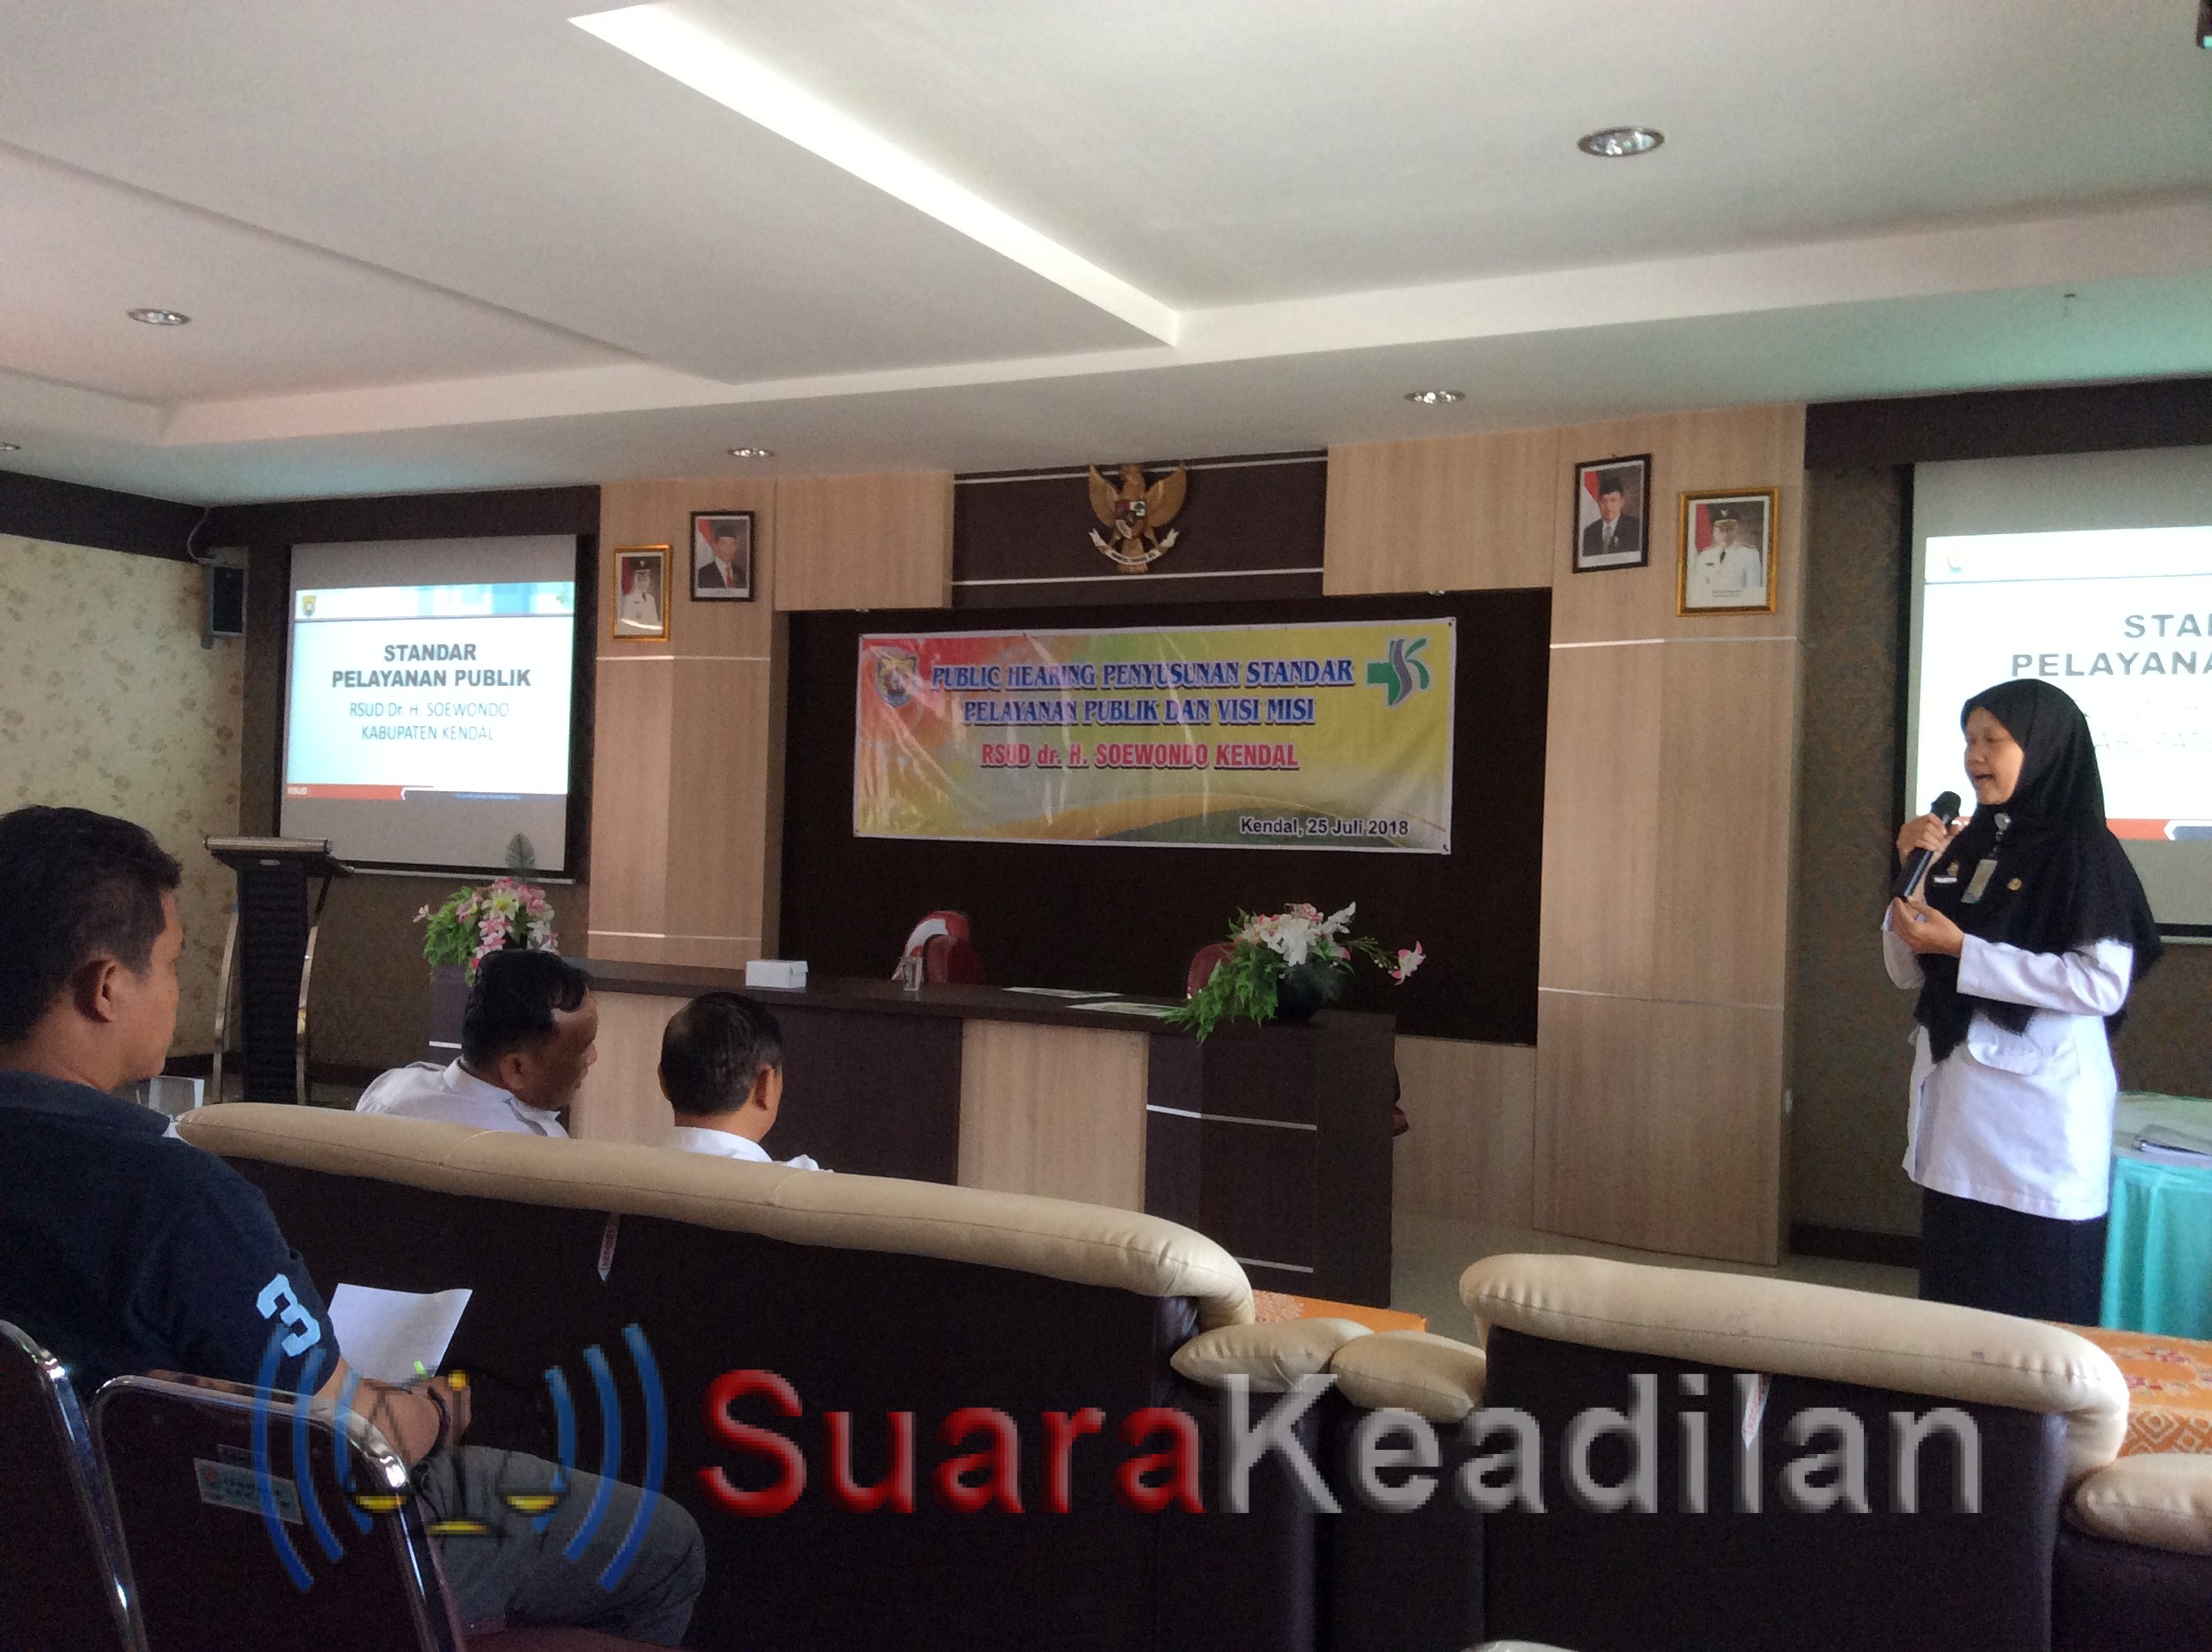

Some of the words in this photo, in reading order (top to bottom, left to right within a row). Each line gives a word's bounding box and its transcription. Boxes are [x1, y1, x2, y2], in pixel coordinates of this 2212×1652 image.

[2124, 614, 2212, 638] STA
[383, 643, 477, 662] STANDAR
[332, 670, 447, 689] PELAYANAN
[454, 668, 532, 688] PUBLIK
[931, 666, 1001, 689] PUBLIC
[1007, 665, 1096, 688] HEARING
[1103, 661, 1240, 686] PENYUSUNAN
[1246, 660, 1354, 684] STANDAR
[349, 702, 385, 718] RSUD
[427, 702, 509, 718] SOEWONDO
[963, 701, 1079, 722] PELAYANAN
[1084, 700, 1160, 722] PUBLIK
[1165, 699, 1210, 721] DAN
[1217, 698, 1260, 721] VISI
[1266, 697, 1315, 720] MISI
[361, 725, 438, 741] KABUPATEN
[442, 726, 494, 741] KENDAL
[981, 743, 1031, 765] RSUD
[1037, 743, 1062, 765] dr.
[1069, 744, 1088, 765] H.
[1096, 743, 1209, 766] SOEWONDO
[1216, 743, 1300, 766] KENDAL
[1241, 817, 1303, 836] Kendal,
[1308, 818, 1328, 835] 25
[1333, 819, 1364, 835] Juli
[1369, 819, 1409, 836] 2018
[256, 1273, 323, 1358] 3
